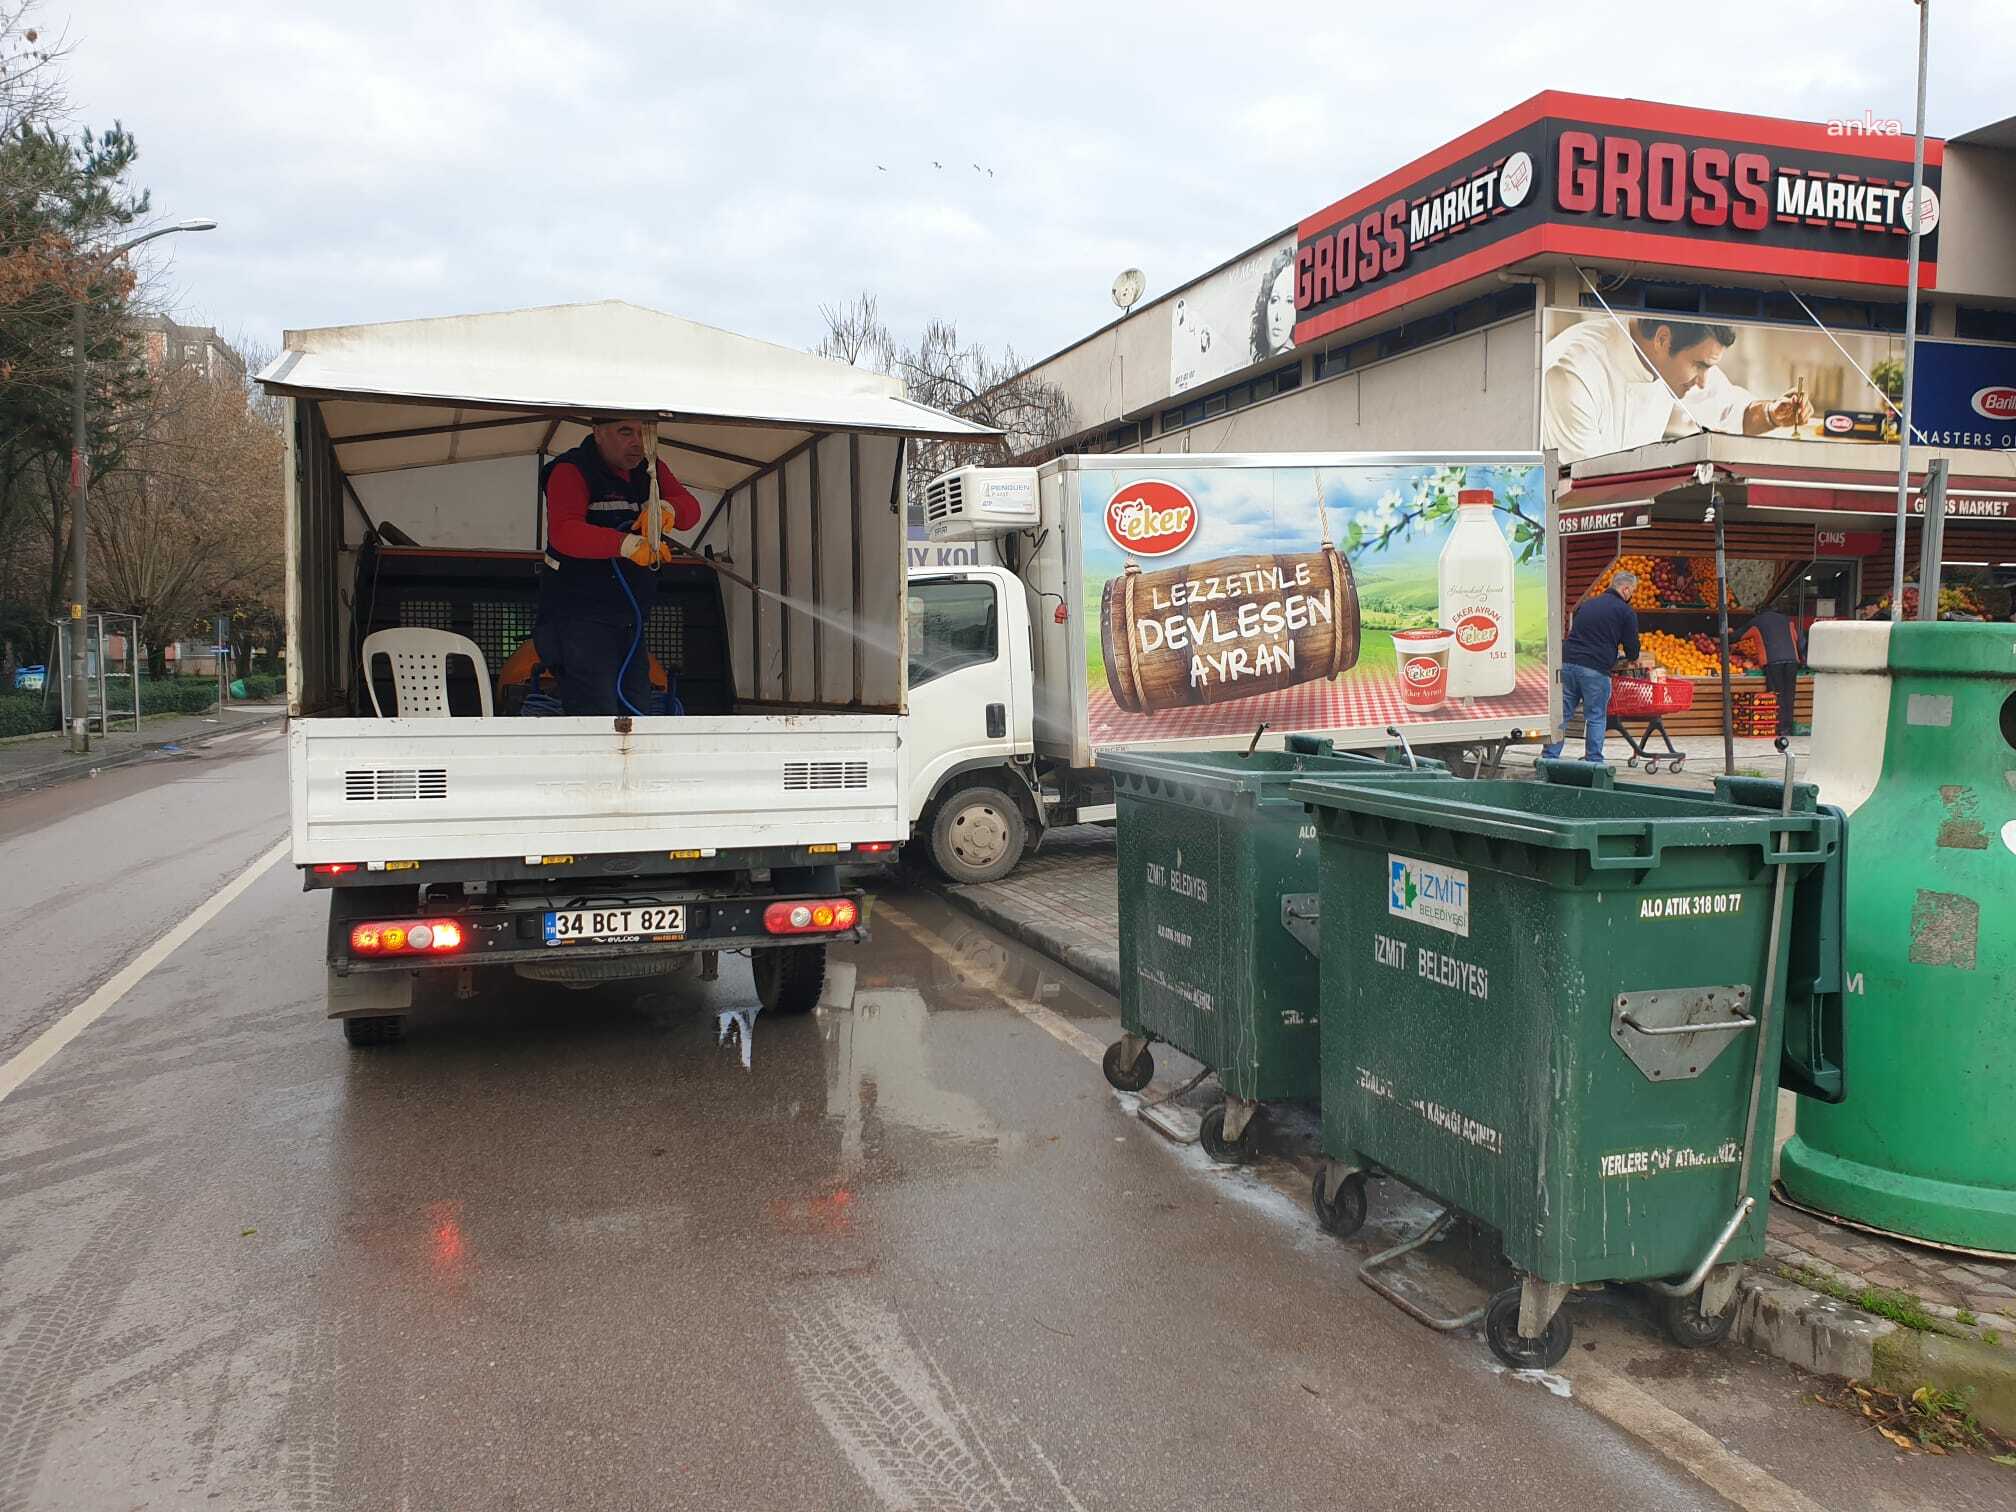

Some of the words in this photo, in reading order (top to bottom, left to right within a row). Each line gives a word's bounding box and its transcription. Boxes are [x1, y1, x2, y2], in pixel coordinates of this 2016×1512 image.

[1558, 130, 1770, 232] GROSS
[1777, 177, 1900, 225] MARKET
[1294, 200, 1408, 311] GROSS
[1410, 171, 1498, 244] MARKET
[1917, 431, 1992, 446] MASTERS
[2001, 434, 2016, 447] O
[1580, 512, 1624, 531] MARKET
[1959, 500, 2009, 516] MARKET
[1125, 504, 1191, 541] eker
[1152, 563, 1311, 610] LEZZETİYLE
[1137, 589, 1332, 653] DEVLEŞEN
[1452, 606, 1473, 623] EKER
[1190, 640, 1296, 687] AYRAN
[1299, 826, 1317, 839] ALO
[1420, 868, 1465, 906] İZMİT
[1419, 903, 1466, 928] BELEDİYESİ
[1640, 899, 1663, 918] ALO
[1664, 897, 1691, 916] ATIK
[1693, 896, 1712, 914] 318
[1714, 894, 1727, 913] 00
[1728, 893, 1742, 912] 77
[557, 914, 584, 935] 34
[593, 911, 632, 933] BCT
[641, 908, 680, 930] 822
[1374, 933, 1407, 970] İZMİT
[1418, 948, 1488, 1000] BELEDİYESİ
[1601, 1152, 1648, 1177] YERLERE
